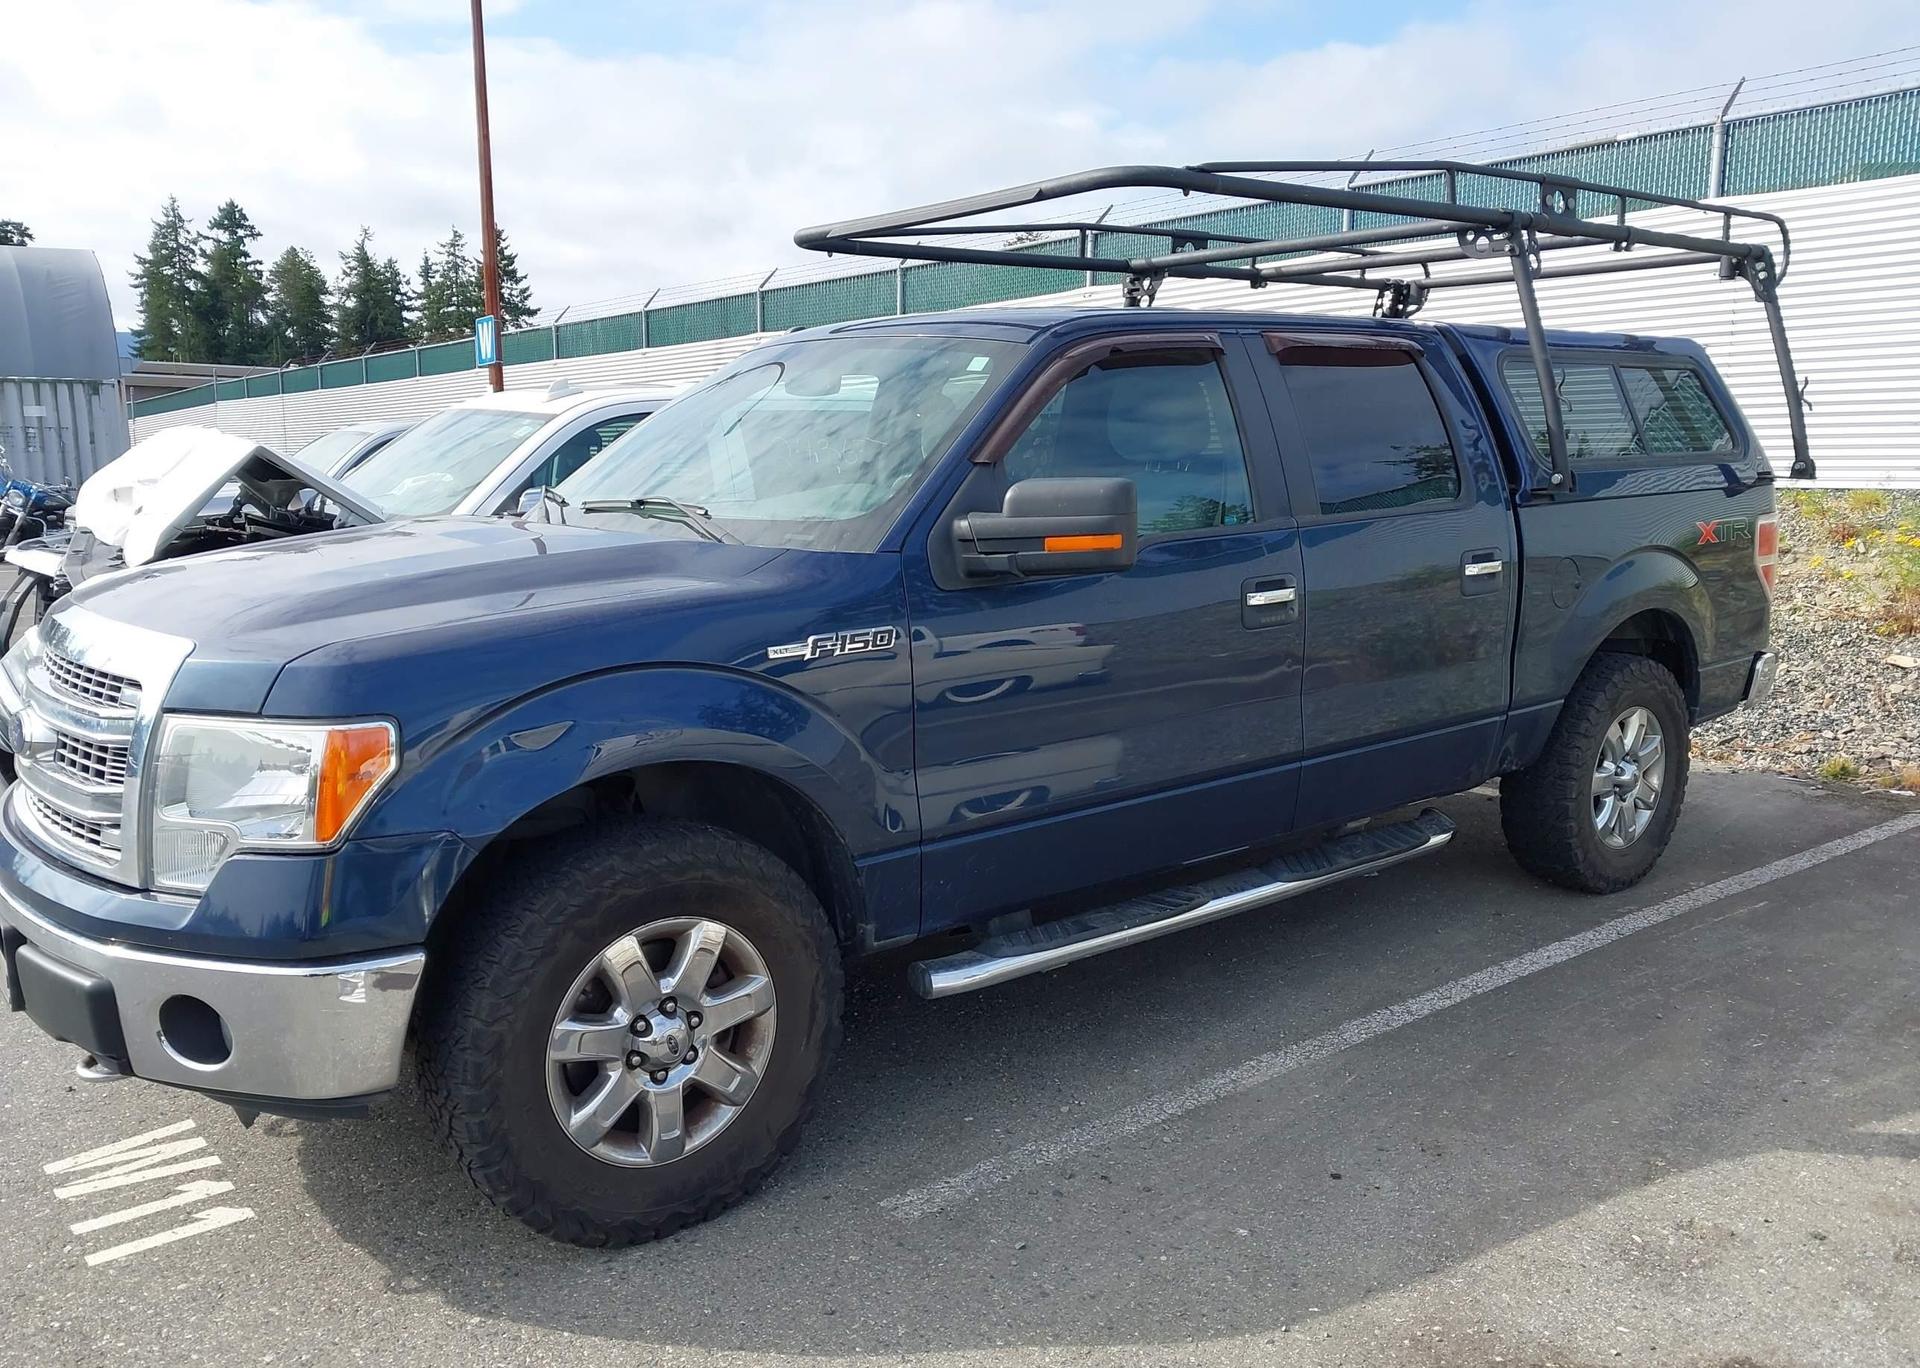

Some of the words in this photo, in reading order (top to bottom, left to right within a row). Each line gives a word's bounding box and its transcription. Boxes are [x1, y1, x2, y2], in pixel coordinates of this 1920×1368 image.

[478, 320, 492, 360] W
[1696, 517, 1752, 545] XTR
[771, 647, 790, 656] XLT
[804, 625, 896, 661] F-150
